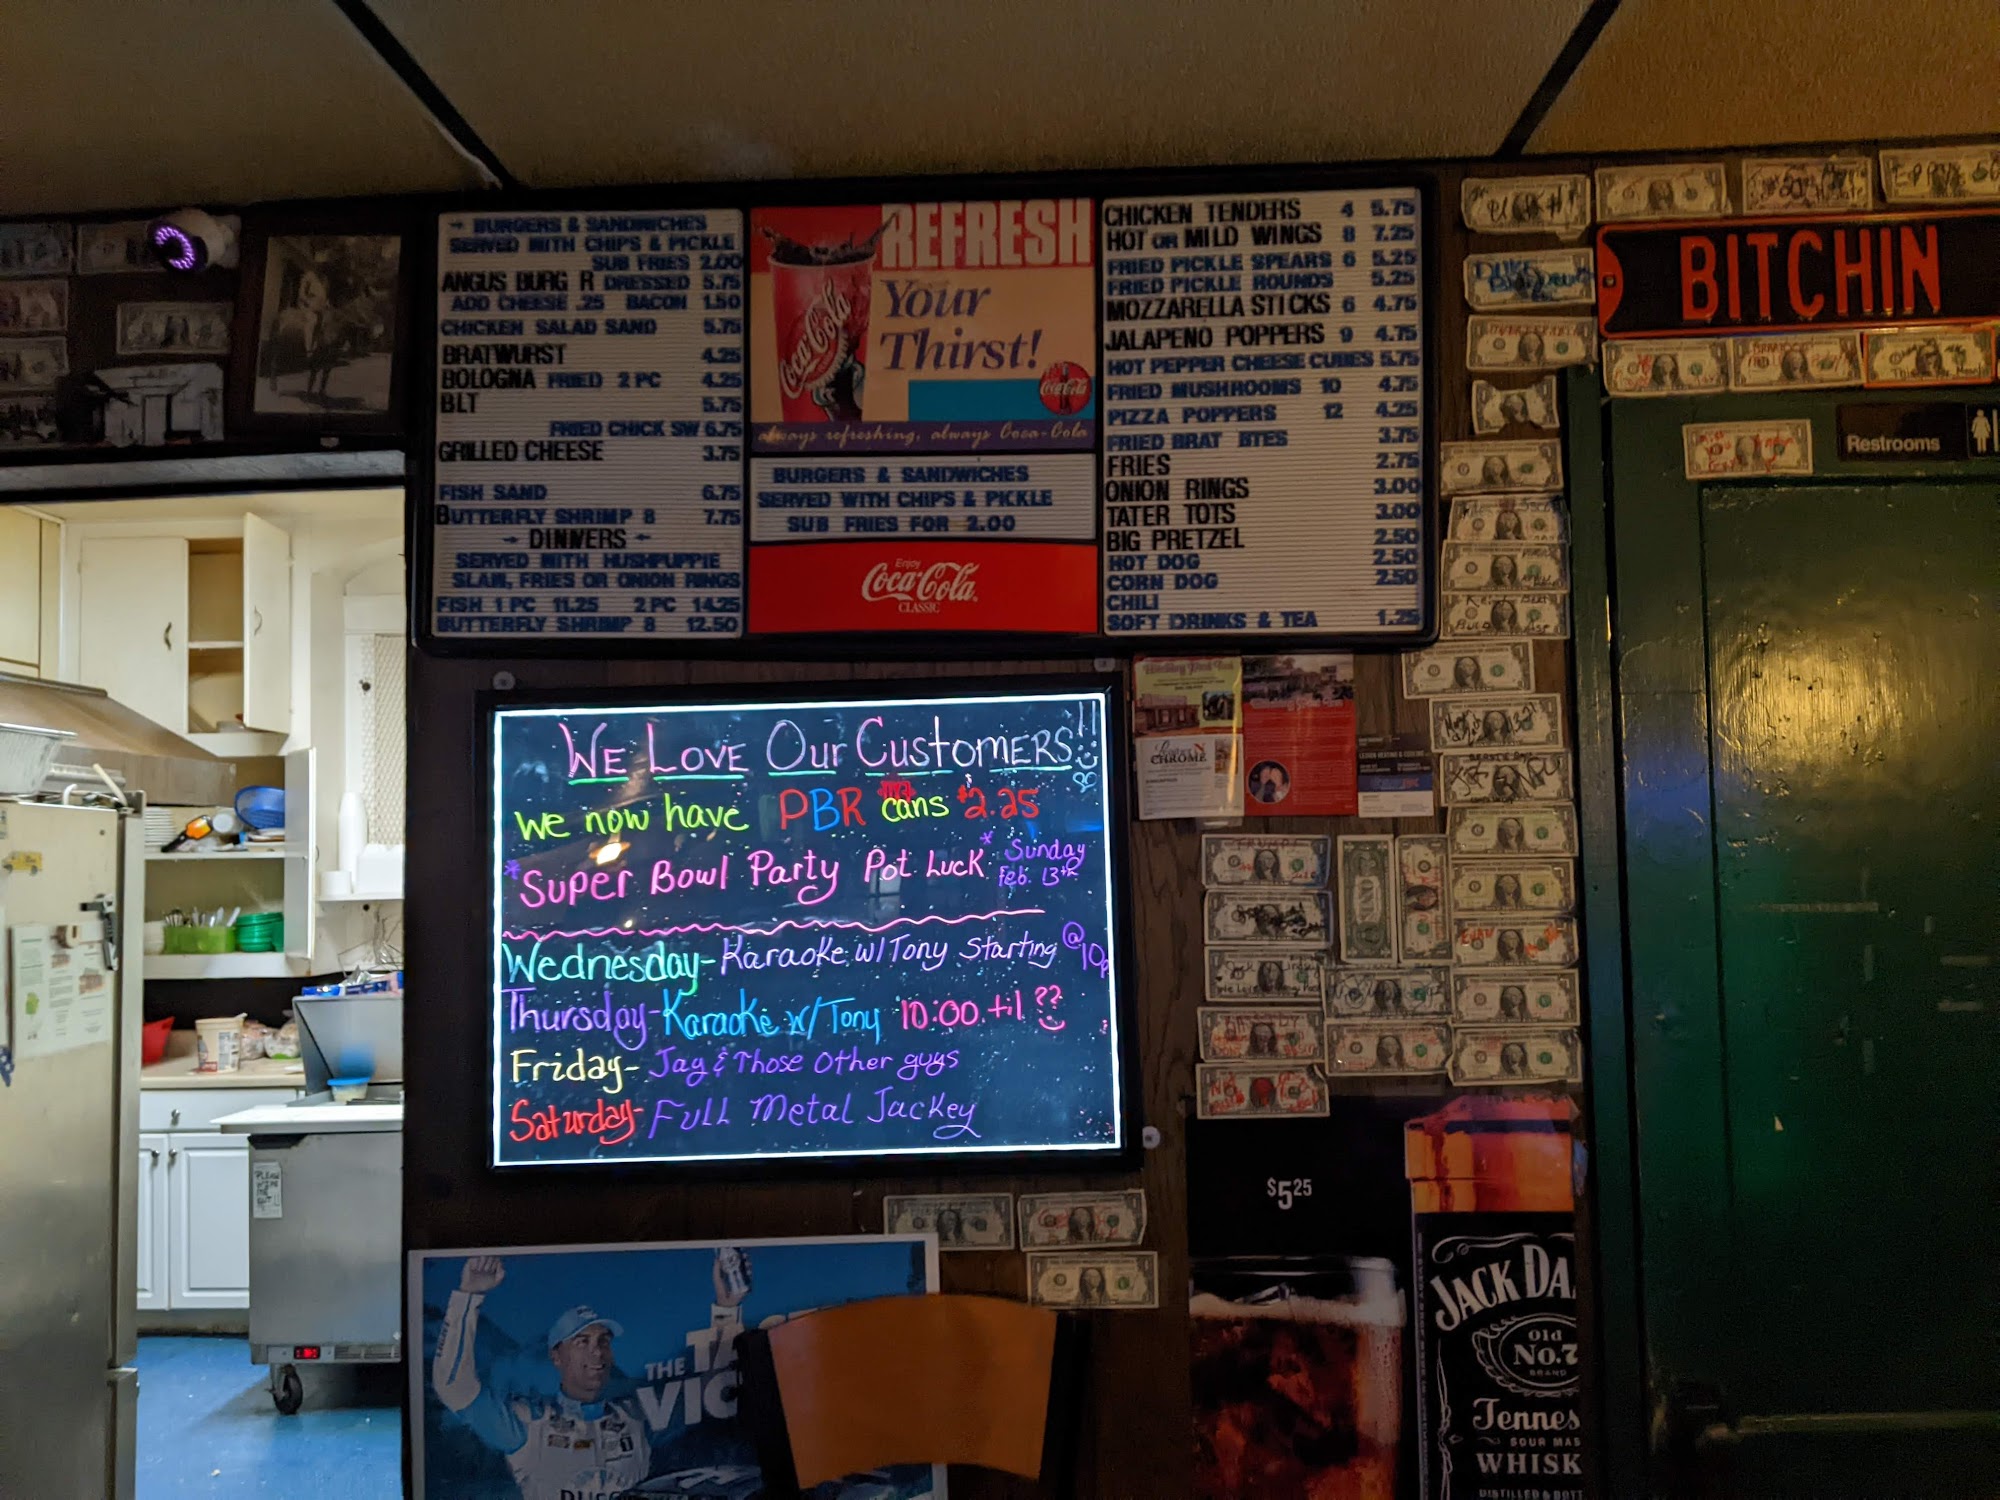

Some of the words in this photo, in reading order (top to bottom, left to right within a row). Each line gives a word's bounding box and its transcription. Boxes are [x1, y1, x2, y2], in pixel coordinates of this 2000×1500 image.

[1105, 204, 1192, 226] CHICKEN
[1208, 200, 1300, 222] TENDERS
[1342, 202, 1353, 217] 4
[1371, 200, 1415, 216] 5.75
[882, 200, 1091, 268] REFRESH
[1107, 230, 1148, 250] HOT
[1153, 234, 1177, 248] OR
[1185, 227, 1238, 247] MILD
[1252, 224, 1322, 245] WINGS
[1343, 227, 1355, 242] 8
[1375, 225, 1414, 241] 7.25
[1108, 279, 1163, 295] FRIED
[1171, 276, 1242, 292] PICKLE
[1253, 273, 1333, 290] ROUNDS
[1372, 271, 1415, 286] 5.25
[1680, 224, 1941, 324] BITCHIN
[880, 280, 991, 317] Your
[1106, 297, 1244, 321] MOZZARELLA
[1252, 294, 1330, 315] STICKS
[1342, 297, 1355, 313] 6
[1374, 296, 1416, 311] 4.75
[1105, 328, 1212, 350] JALAPENO
[1227, 323, 1324, 347] POPPERS
[1375, 326, 1417, 342] 4.75
[442, 344, 566, 364] BRATWURST
[703, 349, 741, 363] 4.25
[880, 328, 1042, 370] Thirst!
[441, 393, 479, 413] BLT
[703, 398, 741, 412] 5.75
[758, 425, 817, 450] always
[931, 424, 991, 449] always
[1000, 421, 1087, 439] Coca-Cola
[1846, 434, 1941, 454] Restrooms
[439, 442, 517, 461] GRILLED
[526, 441, 603, 461] CHEESE
[703, 446, 739, 461] 3.75
[774, 467, 865, 483] BURGERS
[878, 467, 890, 482] &
[902, 466, 1029, 482] SANDWICHES
[1108, 455, 1170, 476] FRIES
[1376, 453, 1419, 468] 2.75
[439, 485, 483, 500] FISH
[494, 485, 547, 500] SAND
[703, 485, 740, 500] 6.75
[759, 492, 830, 508] SERVED
[840, 492, 889, 507] WITH
[898, 491, 955, 507] CHIPS
[964, 491, 976, 506] &
[986, 490, 1052, 506] PICKLE
[1106, 479, 1169, 501] ONION
[1186, 477, 1249, 499] RINGS
[1374, 478, 1420, 494] 3.00
[436, 505, 547, 524] BUTTERFLY
[555, 509, 632, 524] SHRIMP
[644, 509, 654, 524] 8
[705, 509, 740, 524] 7.75
[788, 517, 828, 533] SUB
[845, 517, 898, 532] FRIES
[911, 516, 948, 531] FOR
[968, 516, 1015, 531] 2.00
[1107, 506, 1169, 526] TATER
[1185, 503, 1235, 524] TOTS
[1376, 503, 1420, 519] 3.00
[530, 529, 626, 549] DINNERS
[1107, 531, 1140, 551] BIG
[1153, 528, 1244, 549] PRETZEL
[1374, 529, 1419, 545] 2.50
[456, 554, 528, 568] SERVED
[541, 553, 588, 568] WITH
[604, 553, 720, 568] HUSHPUPPIE
[895, 559, 921, 569] Enjoy
[1109, 556, 1147, 571] HOT
[1158, 554, 1199, 569] DOG
[1373, 550, 1417, 565] 2.50
[1108, 575, 1163, 590] CORN
[1175, 573, 1218, 588] DOG
[1376, 570, 1418, 585] 2.50
[898, 602, 940, 613] CLASSIC
[1108, 595, 1158, 611] CHILI
[437, 617, 546, 632] BUTTERFLY
[557, 617, 632, 632] SHRIMP
[644, 617, 655, 632] 8
[687, 617, 737, 632] 12.50
[1108, 615, 1160, 630] SOFT
[1170, 613, 1245, 629] DRINKS
[1258, 612, 1271, 628] &
[1281, 611, 1318, 627] TEA
[1378, 611, 1419, 625] 1.25
[585, 809, 648, 834] now
[664, 793, 749, 832] have
[779, 787, 867, 831] PBR
[882, 796, 949, 822] cans
[1005, 839, 1085, 871] Sunday
[651, 855, 728, 894] Bowl
[747, 850, 839, 905] Party
[865, 849, 911, 883] Pot
[720, 934, 846, 976] Karaoke
[960, 931, 1057, 969] Starting
[1063, 921, 1085, 949] @
[663, 988, 780, 1040] Karaoke
[901, 1000, 979, 1030] 10:00
[713, 1046, 728, 1077] &
[733, 1048, 803, 1073] Those
[814, 1046, 893, 1075] Other
[897, 1049, 959, 1081] guys
[750, 1092, 854, 1126] Metal
[867, 1086, 981, 1139] Jackey
[1429, 1259, 1522, 1331] JACK
[1522, 1244, 1577, 1300] DA
[645, 1357, 686, 1382] THE
[1510, 1437, 1546, 1447] SOUR
[1476, 1453, 1582, 1474] WHISK
